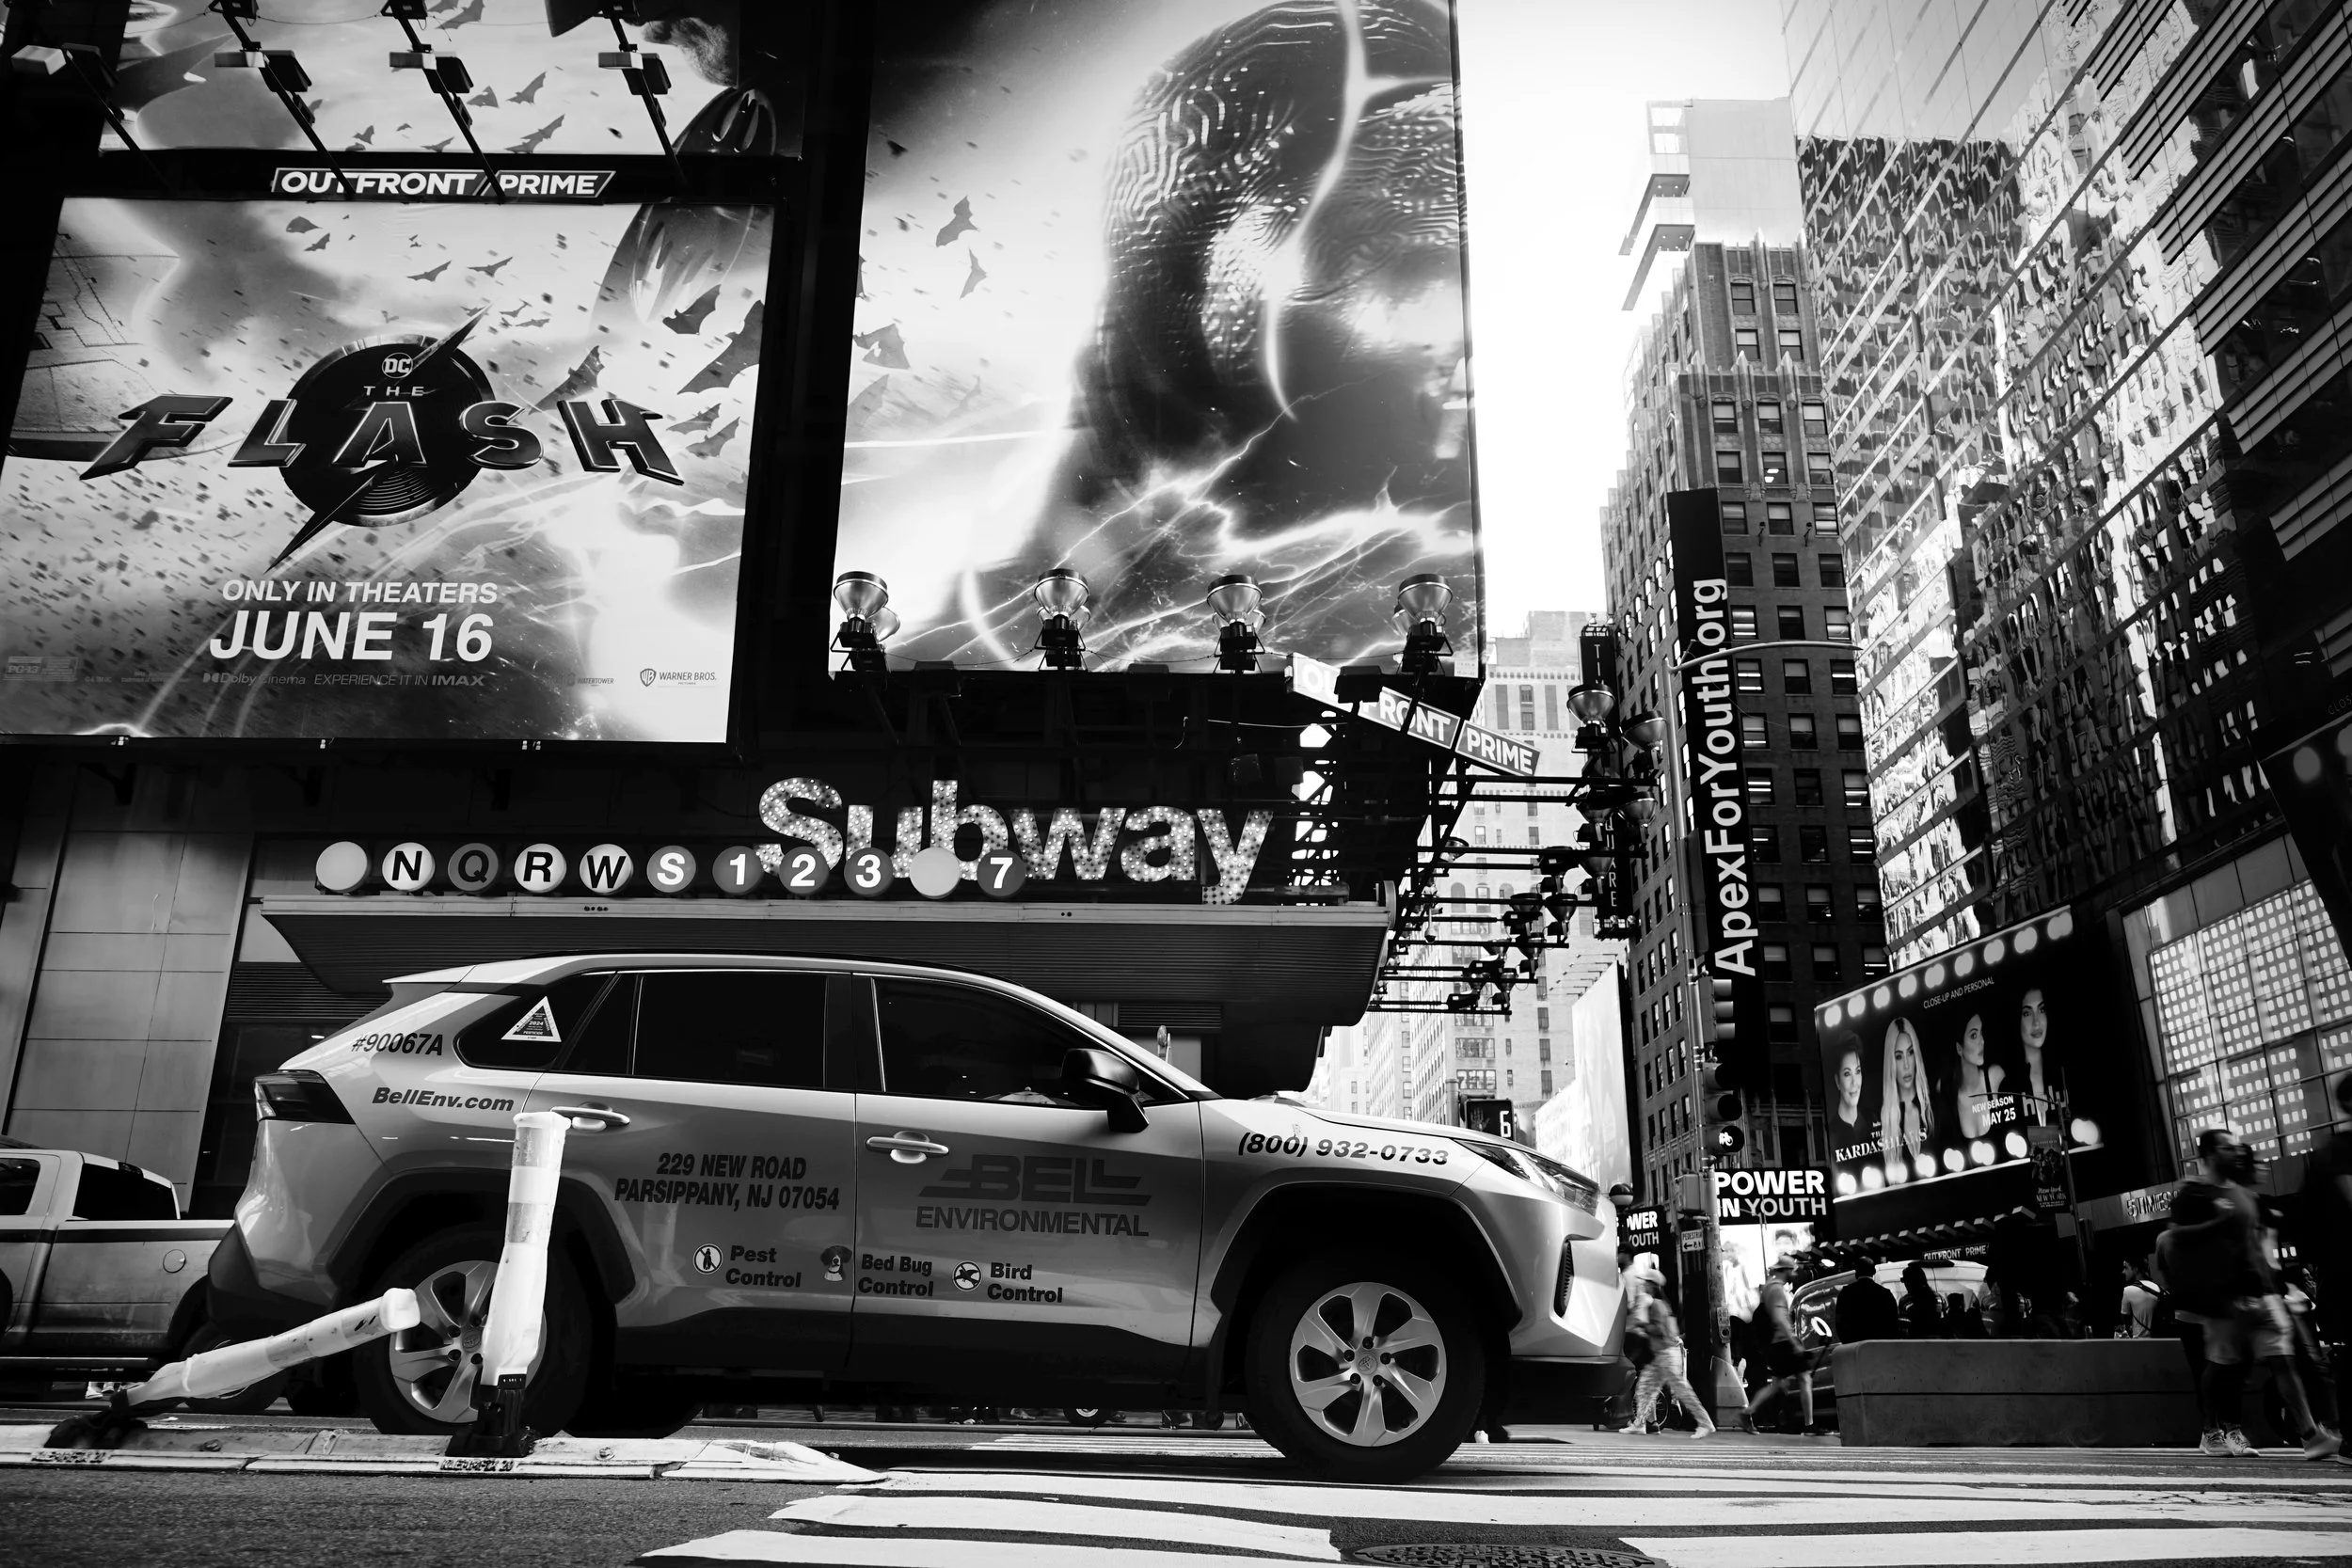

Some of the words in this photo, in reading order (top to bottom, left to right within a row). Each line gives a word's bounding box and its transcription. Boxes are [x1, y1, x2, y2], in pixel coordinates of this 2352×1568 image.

[281, 171, 477, 196] OUTFRONT
[499, 174, 598, 196] PRIME
[384, 356, 413, 375] DC
[363, 385, 425, 397] THE
[79, 392, 684, 486] FLASH
[222, 579, 302, 602] ONLY
[307, 581, 336, 602] IN
[345, 581, 498, 604] THEATERS
[210, 610, 398, 660] JUNE
[422, 613, 494, 662] 16
[8, 665, 39, 675] PG-13
[220, 673, 258, 687] Dolby
[260, 673, 306, 686] Cinema
[313, 673, 397, 687] EXPERIENCE
[399, 674, 412, 686] IT
[414, 674, 429, 686] IN
[431, 674, 485, 687] IMAX
[660, 672, 692, 681] WARNER
[693, 672, 717, 681] BROS.
[2328, 691, 2352, 715] CLOS
[1467, 726, 1534, 775] PRIME
[1692, 578, 1758, 977] ApexForYouth.org
[755, 777, 1274, 905] Subway
[391, 850, 423, 881] N
[458, 849, 490, 884] Q
[523, 851, 553, 882] R
[586, 855, 627, 889] W
[657, 852, 686, 885] S
[729, 853, 746, 885] 1
[790, 859, 816, 887] 2
[855, 860, 882, 888] 3
[990, 858, 1014, 889] 7
[1923, 992, 1950, 1009] CLOSE-UP
[1950, 988, 1963, 1000] AND
[1963, 975, 1995, 997] PERSONAL
[351, 1032, 443, 1055] #90067A
[373, 1086, 515, 1111] BellEnv.com
[1971, 1101, 1986, 1115] NEW
[1986, 1094, 2014, 1111] SEASON
[1981, 1109, 2003, 1128] MAY
[2003, 1106, 2016, 1122] 25
[1238, 1132, 1309, 1158] (800)
[1315, 1138, 1450, 1165] 932-0733
[656, 1151, 695, 1176] 229
[700, 1153, 747, 1179] NEW
[751, 1155, 807, 1180] ROAD
[917, 1153, 1152, 1206] BELL
[1715, 1169, 1826, 1196] POWER
[613, 1177, 739, 1212] PARSIPPANY,
[746, 1183, 773, 1209] NJ
[778, 1185, 840, 1211] 07054
[1717, 1197, 1740, 1218] IN
[1743, 1196, 1827, 1217] YOUTH
[915, 1206, 1150, 1237] ENVIRONMENTAL
[1627, 1211, 1659, 1231] WER
[730, 1244, 778, 1263] Pest
[1923, 1247, 1963, 1260] OUTFRONT
[1964, 1244, 1987, 1258] PRIME
[860, 1253, 895, 1272] Bed
[899, 1256, 932, 1277] Bug
[990, 1261, 1033, 1280] Bird
[725, 1268, 802, 1289] Control
[857, 1276, 934, 1298] Control
[987, 1283, 1063, 1304] Control
